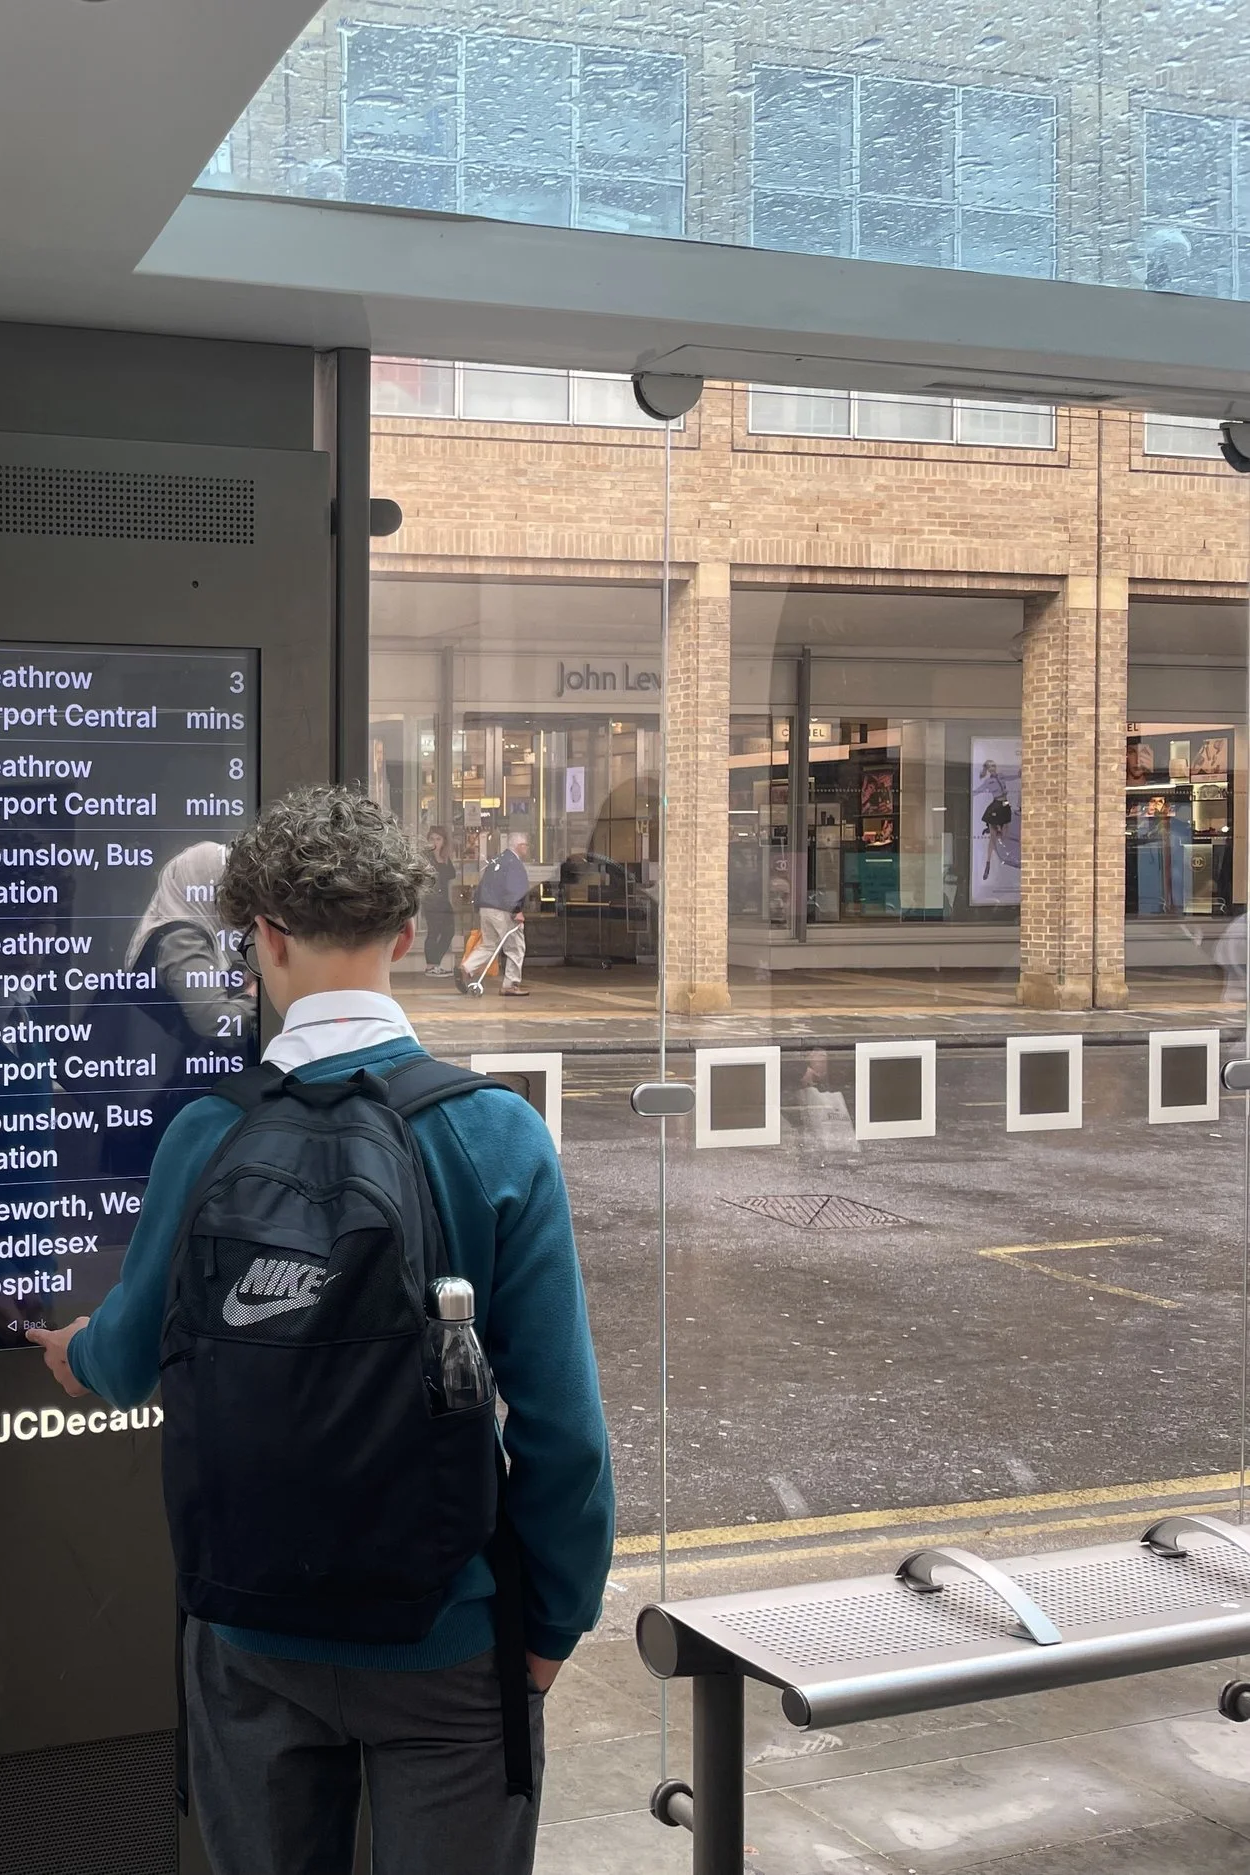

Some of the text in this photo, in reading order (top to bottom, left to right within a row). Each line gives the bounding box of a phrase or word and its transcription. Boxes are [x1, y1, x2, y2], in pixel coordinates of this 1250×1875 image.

[230, 672, 244, 693] 3
[556, 661, 617, 697] John
[65, 704, 156, 728] Central
[187, 707, 244, 729] mins
[229, 758, 243, 779] 8
[65, 793, 156, 815] Central
[187, 794, 243, 815] mins
[108, 844, 153, 865] Bus
[186, 879, 215, 902] mi
[65, 965, 155, 990] Central
[186, 966, 244, 988] mins
[217, 1015, 241, 1036] 21
[65, 1054, 155, 1078] Central
[186, 1051, 243, 1074] mins
[107, 1105, 152, 1127] Bus
[101, 1192, 141, 1215] We
[239, 1257, 327, 1299] NIKE
[24, 1319, 46, 1330] Back
